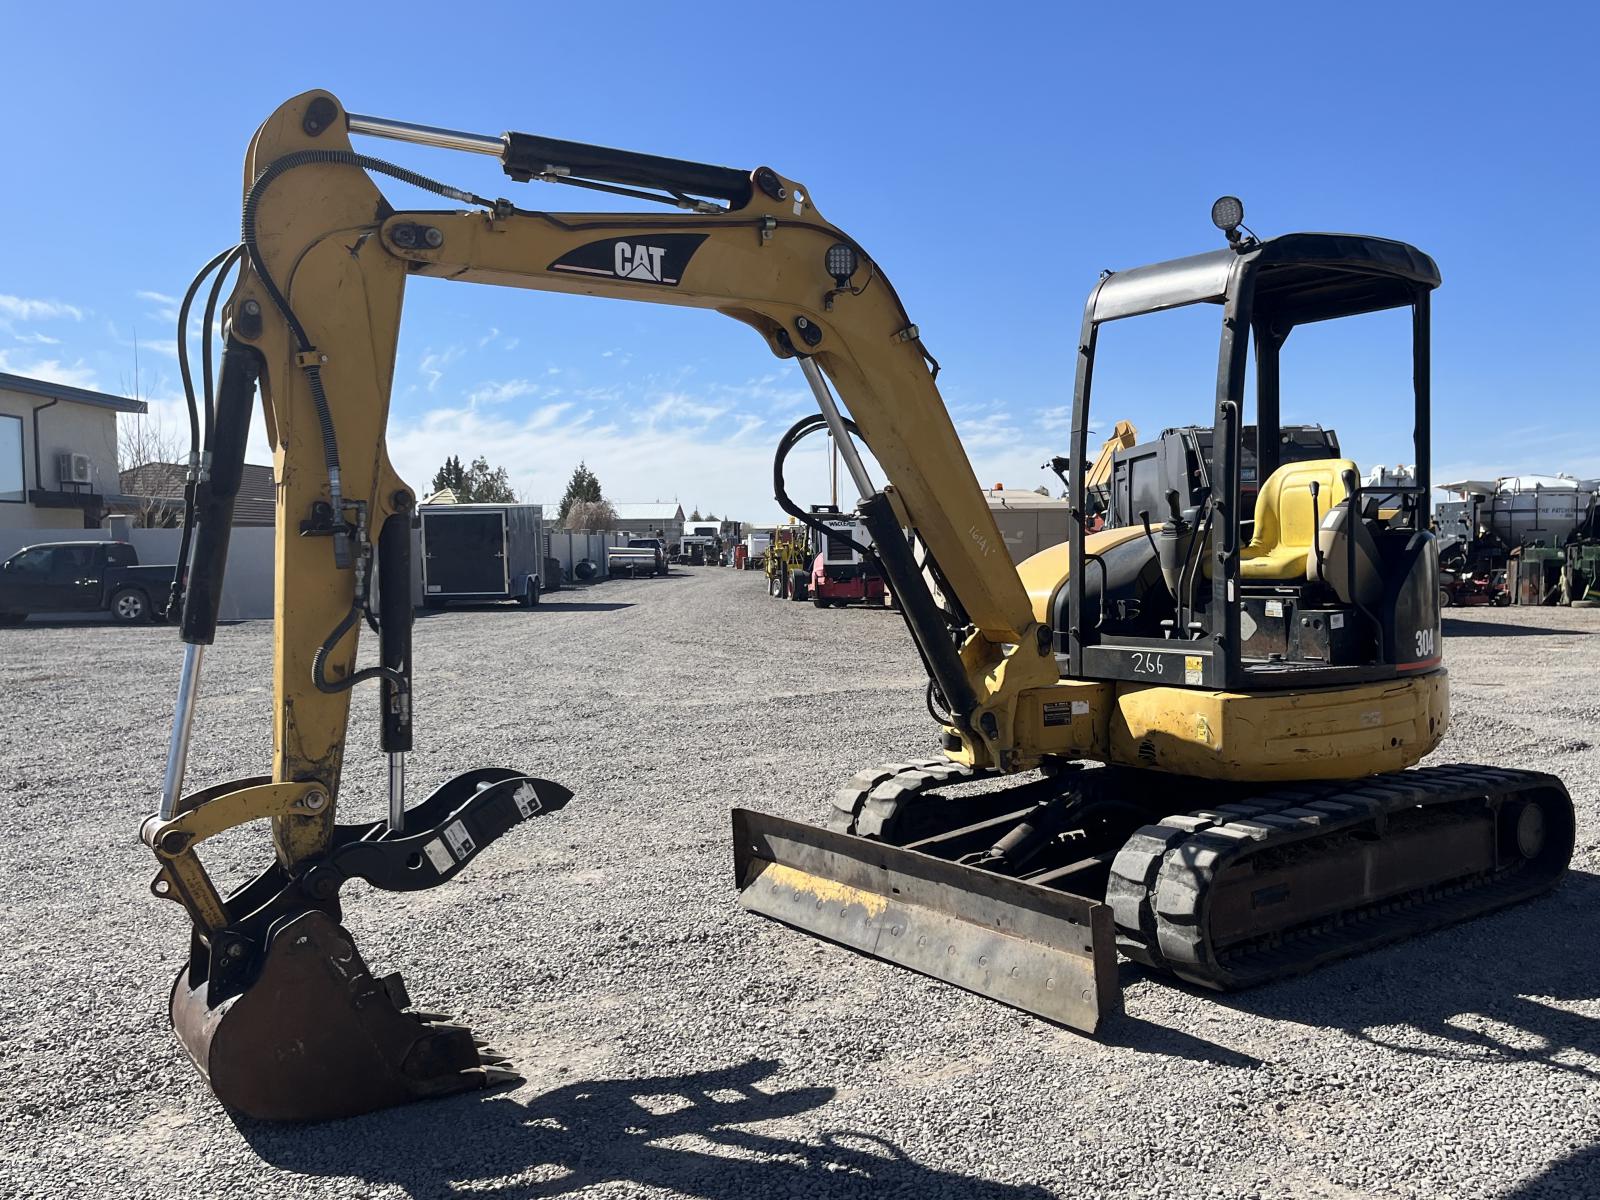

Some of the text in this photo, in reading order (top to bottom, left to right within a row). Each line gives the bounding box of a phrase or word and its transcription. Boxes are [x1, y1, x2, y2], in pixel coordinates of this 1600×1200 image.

[615, 242, 666, 282] CAT
[1416, 628, 1434, 657] 304
[1131, 653, 1164, 674] 266
